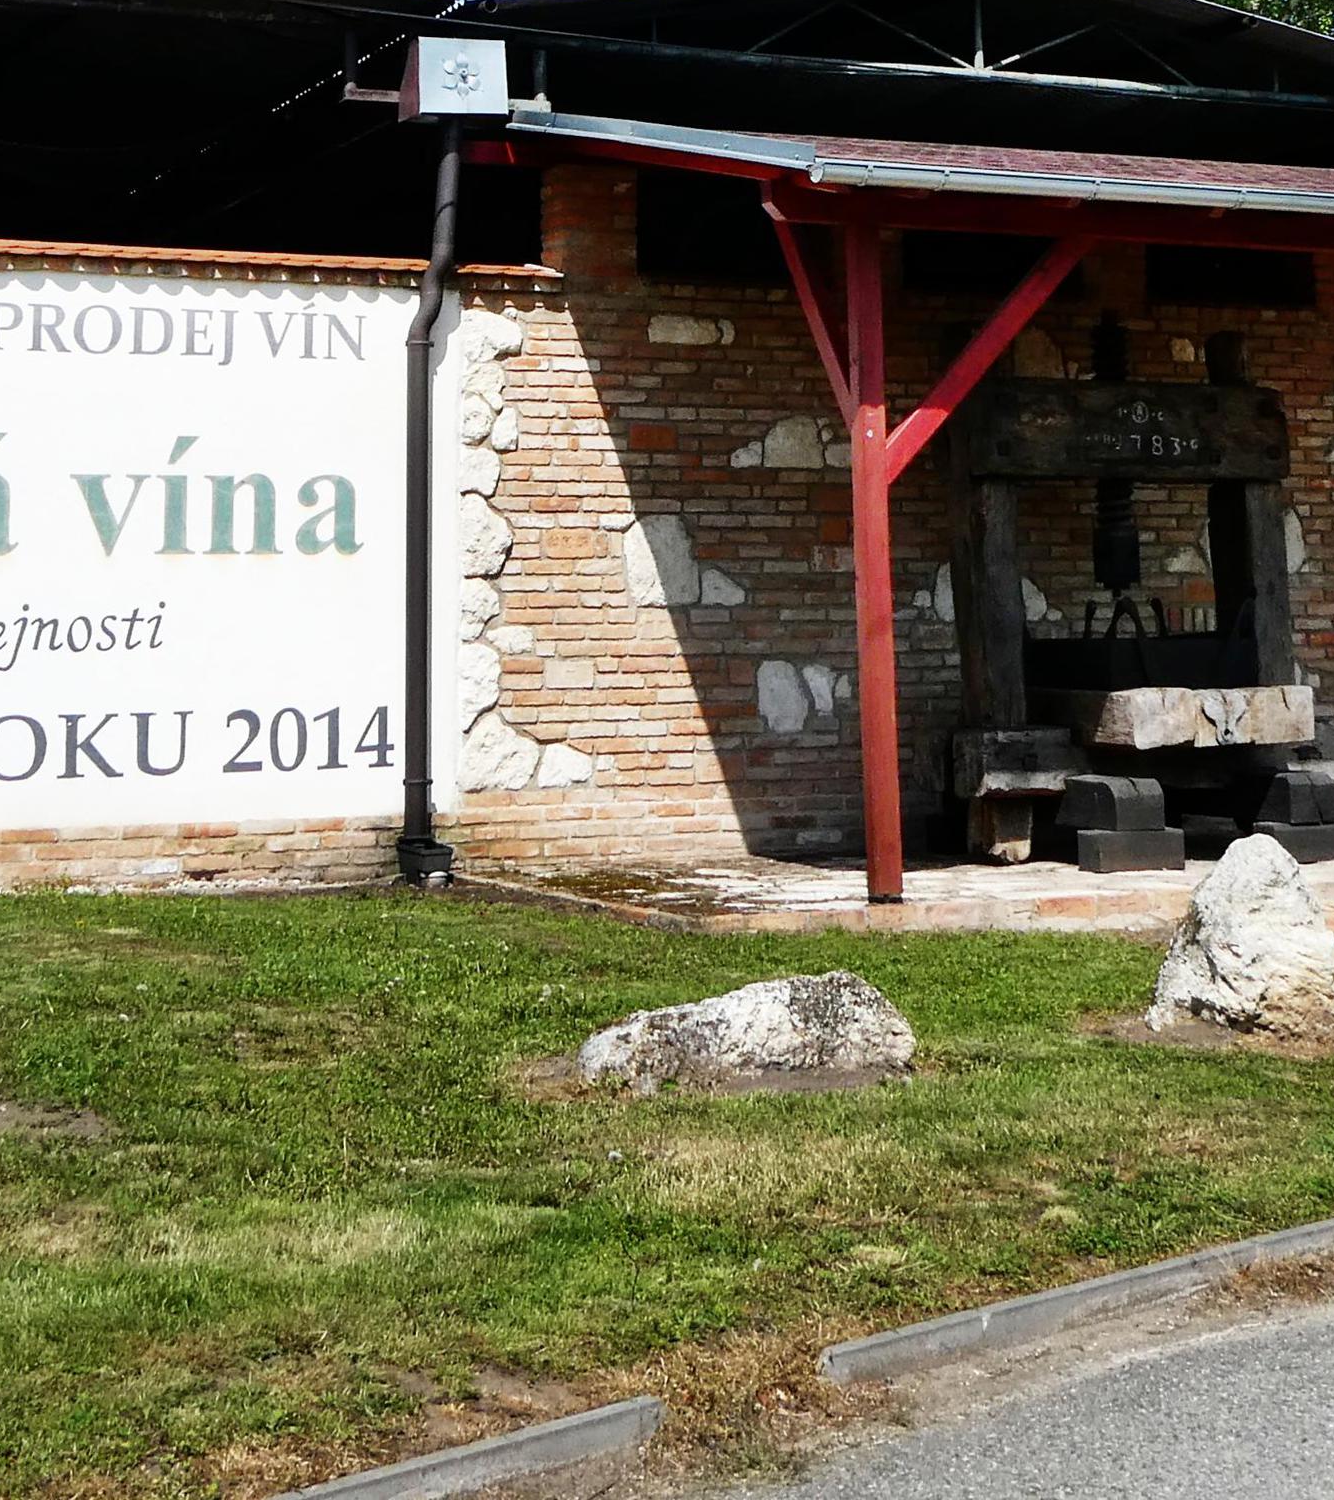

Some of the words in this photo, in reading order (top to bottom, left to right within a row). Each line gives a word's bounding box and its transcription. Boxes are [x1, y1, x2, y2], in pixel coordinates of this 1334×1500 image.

[254, 302, 367, 361] VÍN
[69, 435, 365, 557] vína
[222, 705, 395, 774] 2014
